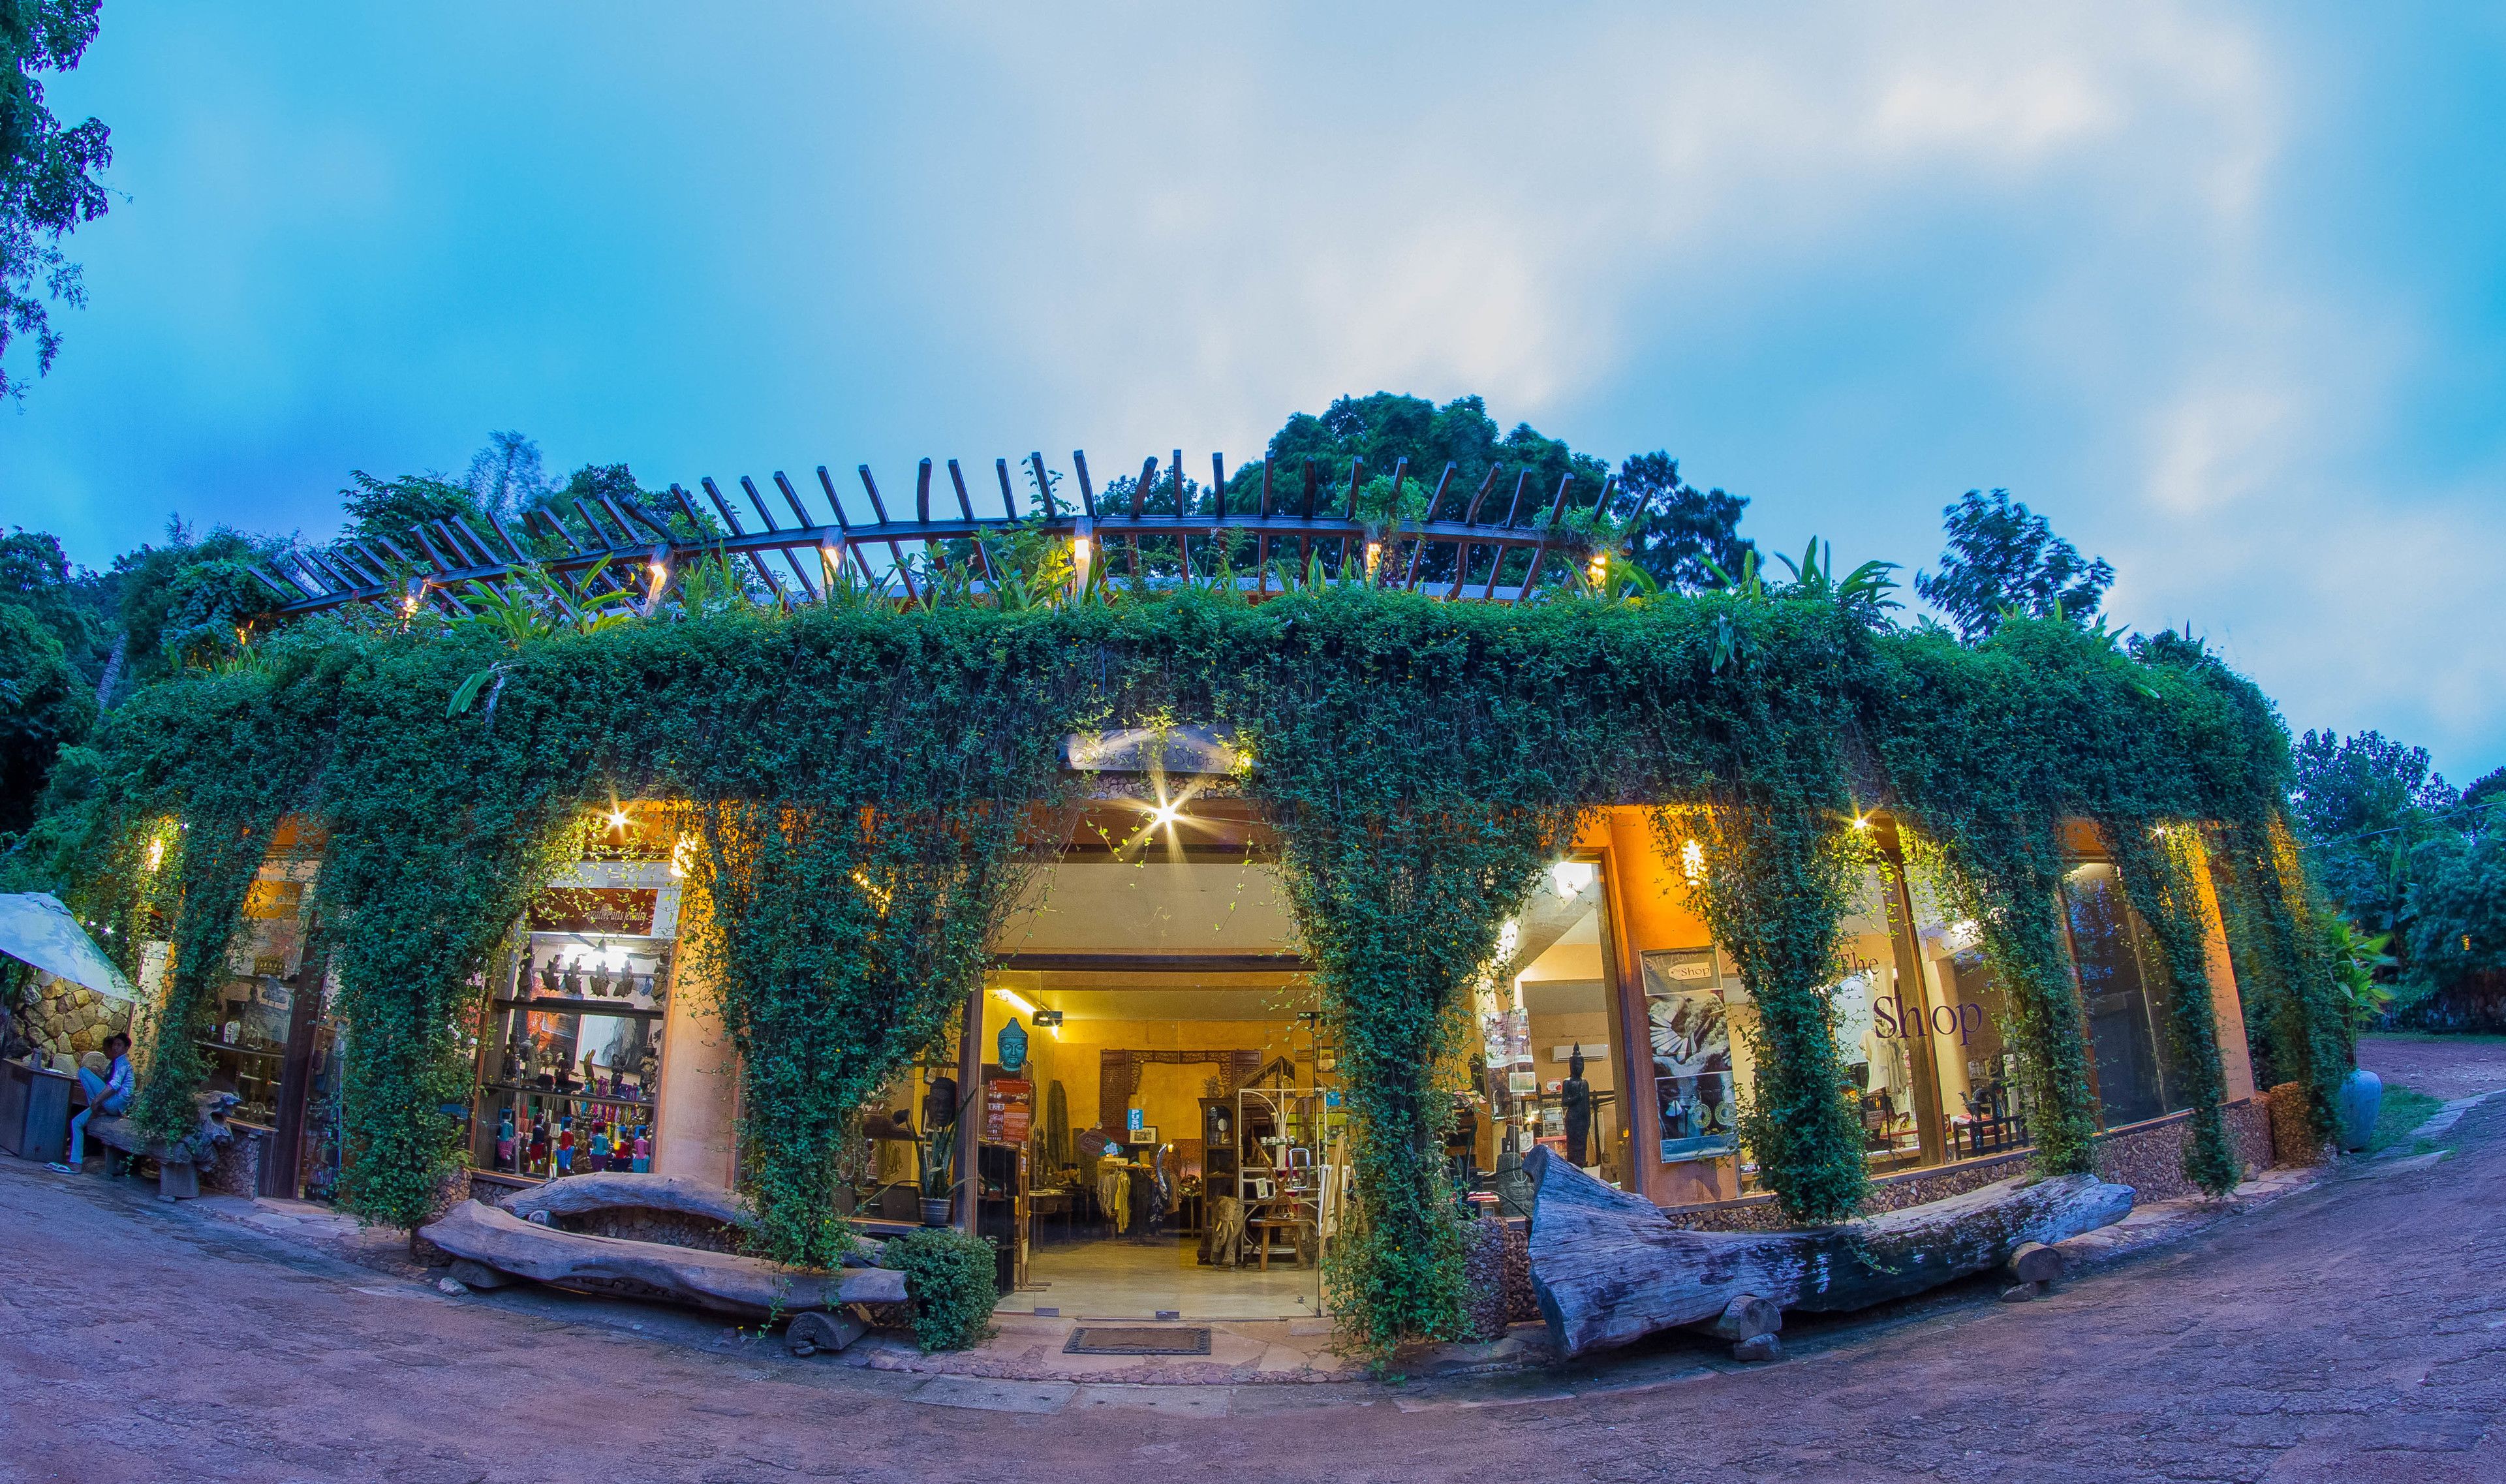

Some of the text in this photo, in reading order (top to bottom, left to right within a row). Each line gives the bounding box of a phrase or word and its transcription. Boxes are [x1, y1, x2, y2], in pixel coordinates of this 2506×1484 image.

[1072, 739, 1214, 771] Artisanl Shop
[611, 909, 624, 920] arts
[1645, 955, 1667, 972] Gift
[1681, 966, 1710, 976] Shop
[1834, 951, 1880, 976] The
[1874, 993, 1982, 1045] Shop
[1131, 1109, 1139, 1129] PUSH
